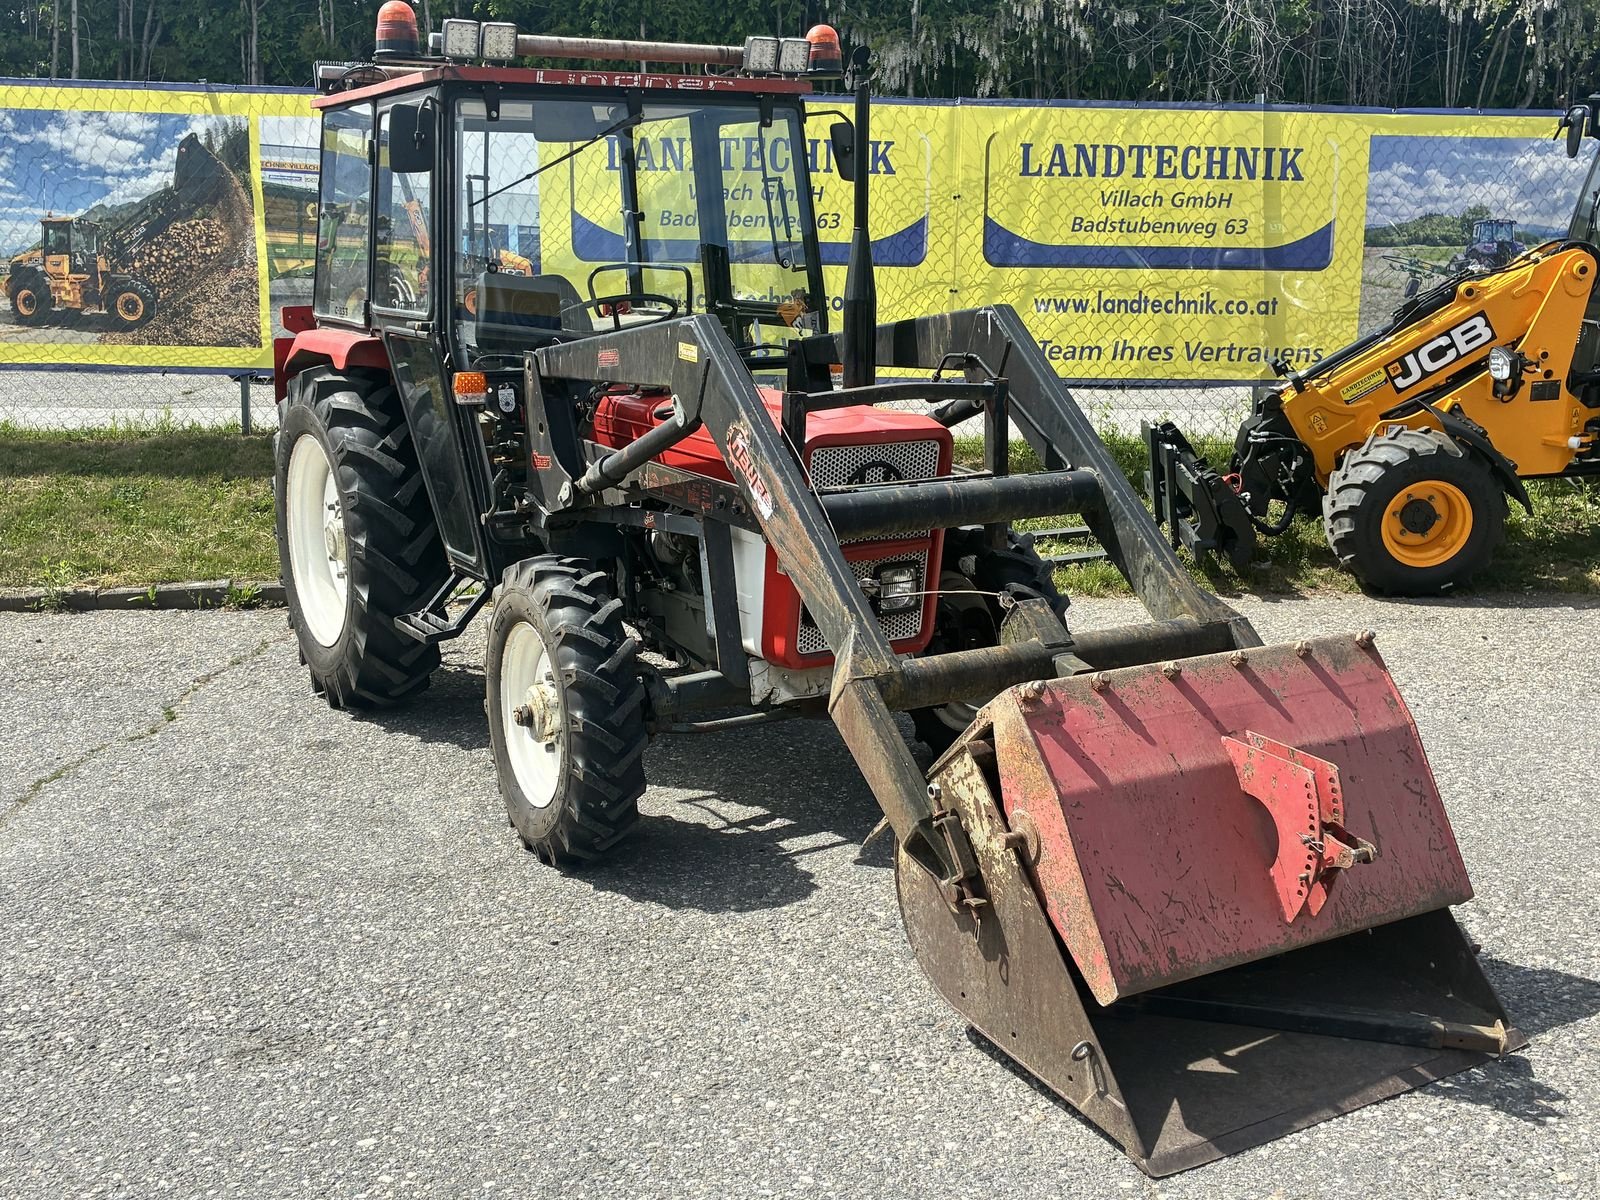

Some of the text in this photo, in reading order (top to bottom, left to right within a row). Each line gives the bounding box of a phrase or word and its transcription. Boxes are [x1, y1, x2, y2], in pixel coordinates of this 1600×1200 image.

[1018, 142, 1305, 182] LANDTECHNIK
[1100, 190, 1233, 209] Villach GmbH
[817, 213, 841, 229] 63
[1071, 216, 1218, 238] Badstubenweg
[1224, 218, 1249, 235] 63
[1034, 290, 1279, 316] www.landtechnik.co.at
[1038, 339, 1325, 363] Team Ihres Vertrauens
[1393, 315, 1492, 389] JCB
[1341, 369, 1383, 395] LANDTECHNIK
